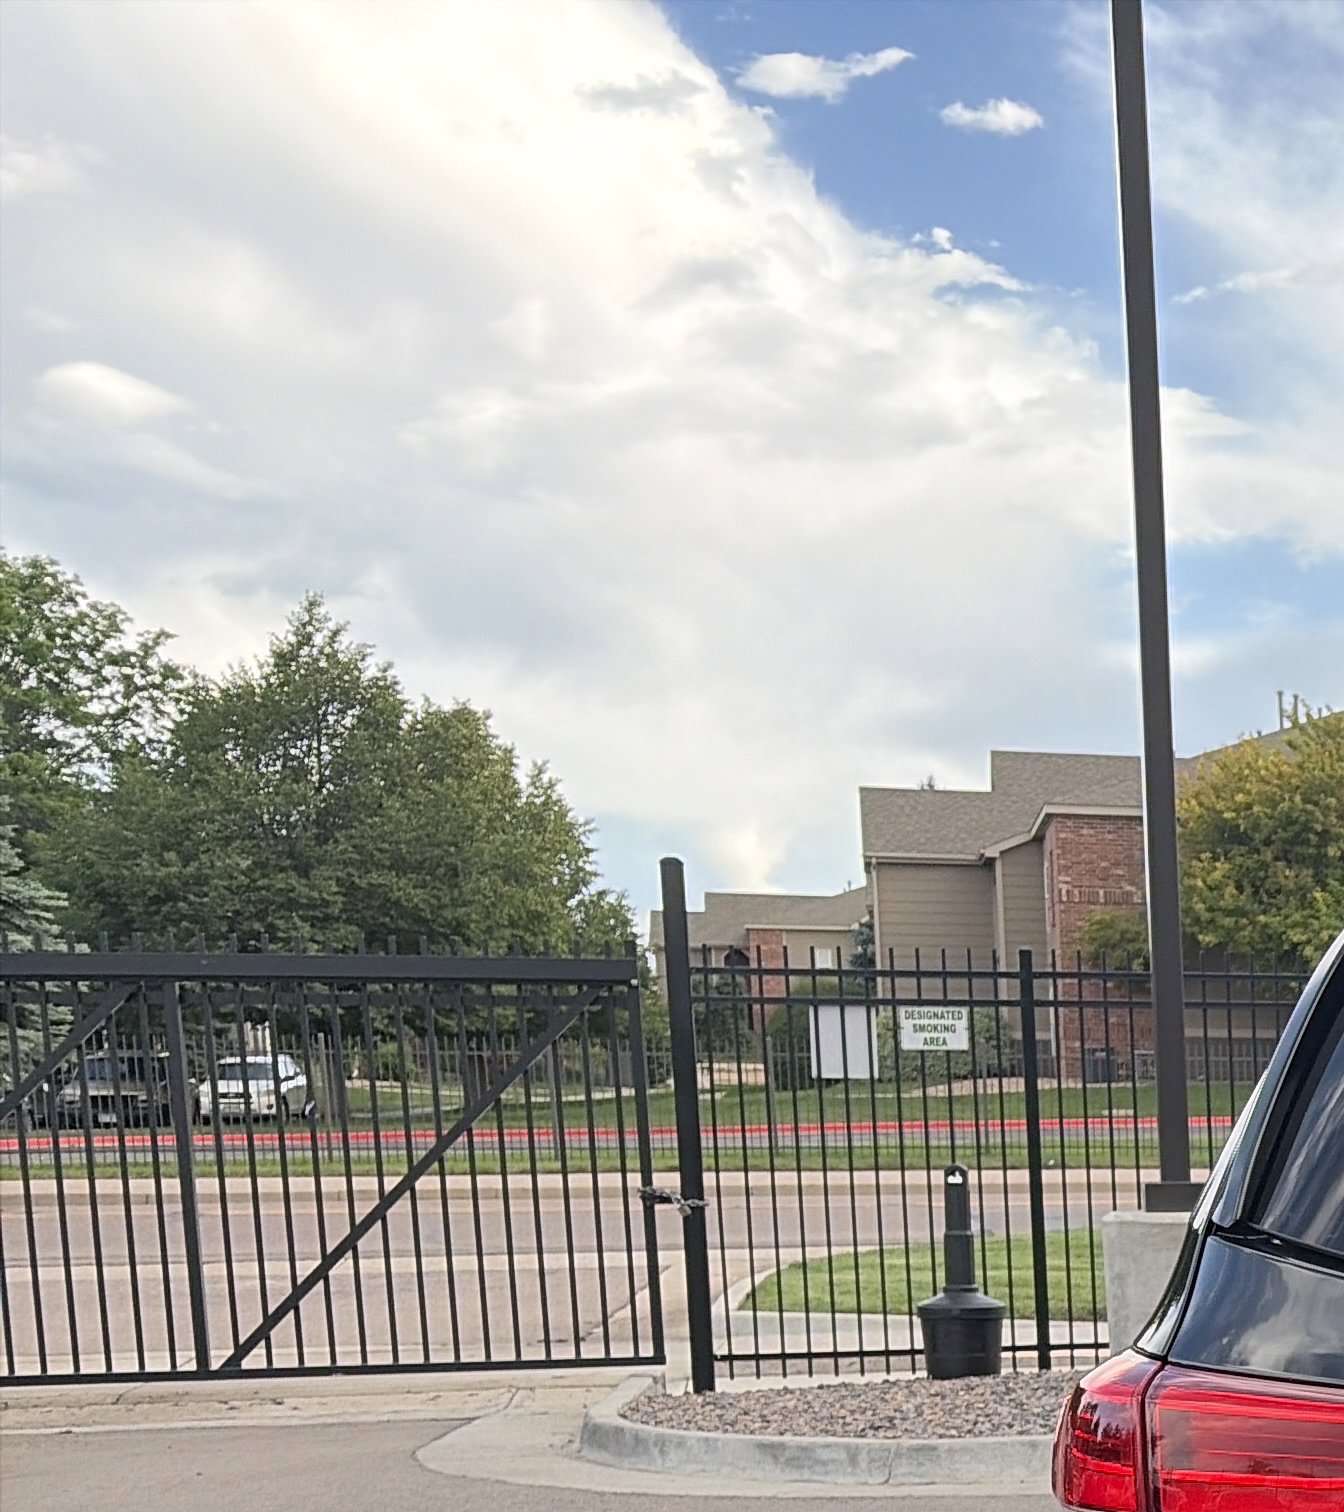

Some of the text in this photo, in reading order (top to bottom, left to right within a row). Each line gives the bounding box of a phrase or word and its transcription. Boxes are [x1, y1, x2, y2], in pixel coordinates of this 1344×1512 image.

[904, 1009, 963, 1021] DESIGNATED
[912, 1023, 957, 1034] SMOKING
[922, 1036, 948, 1047] AREA
